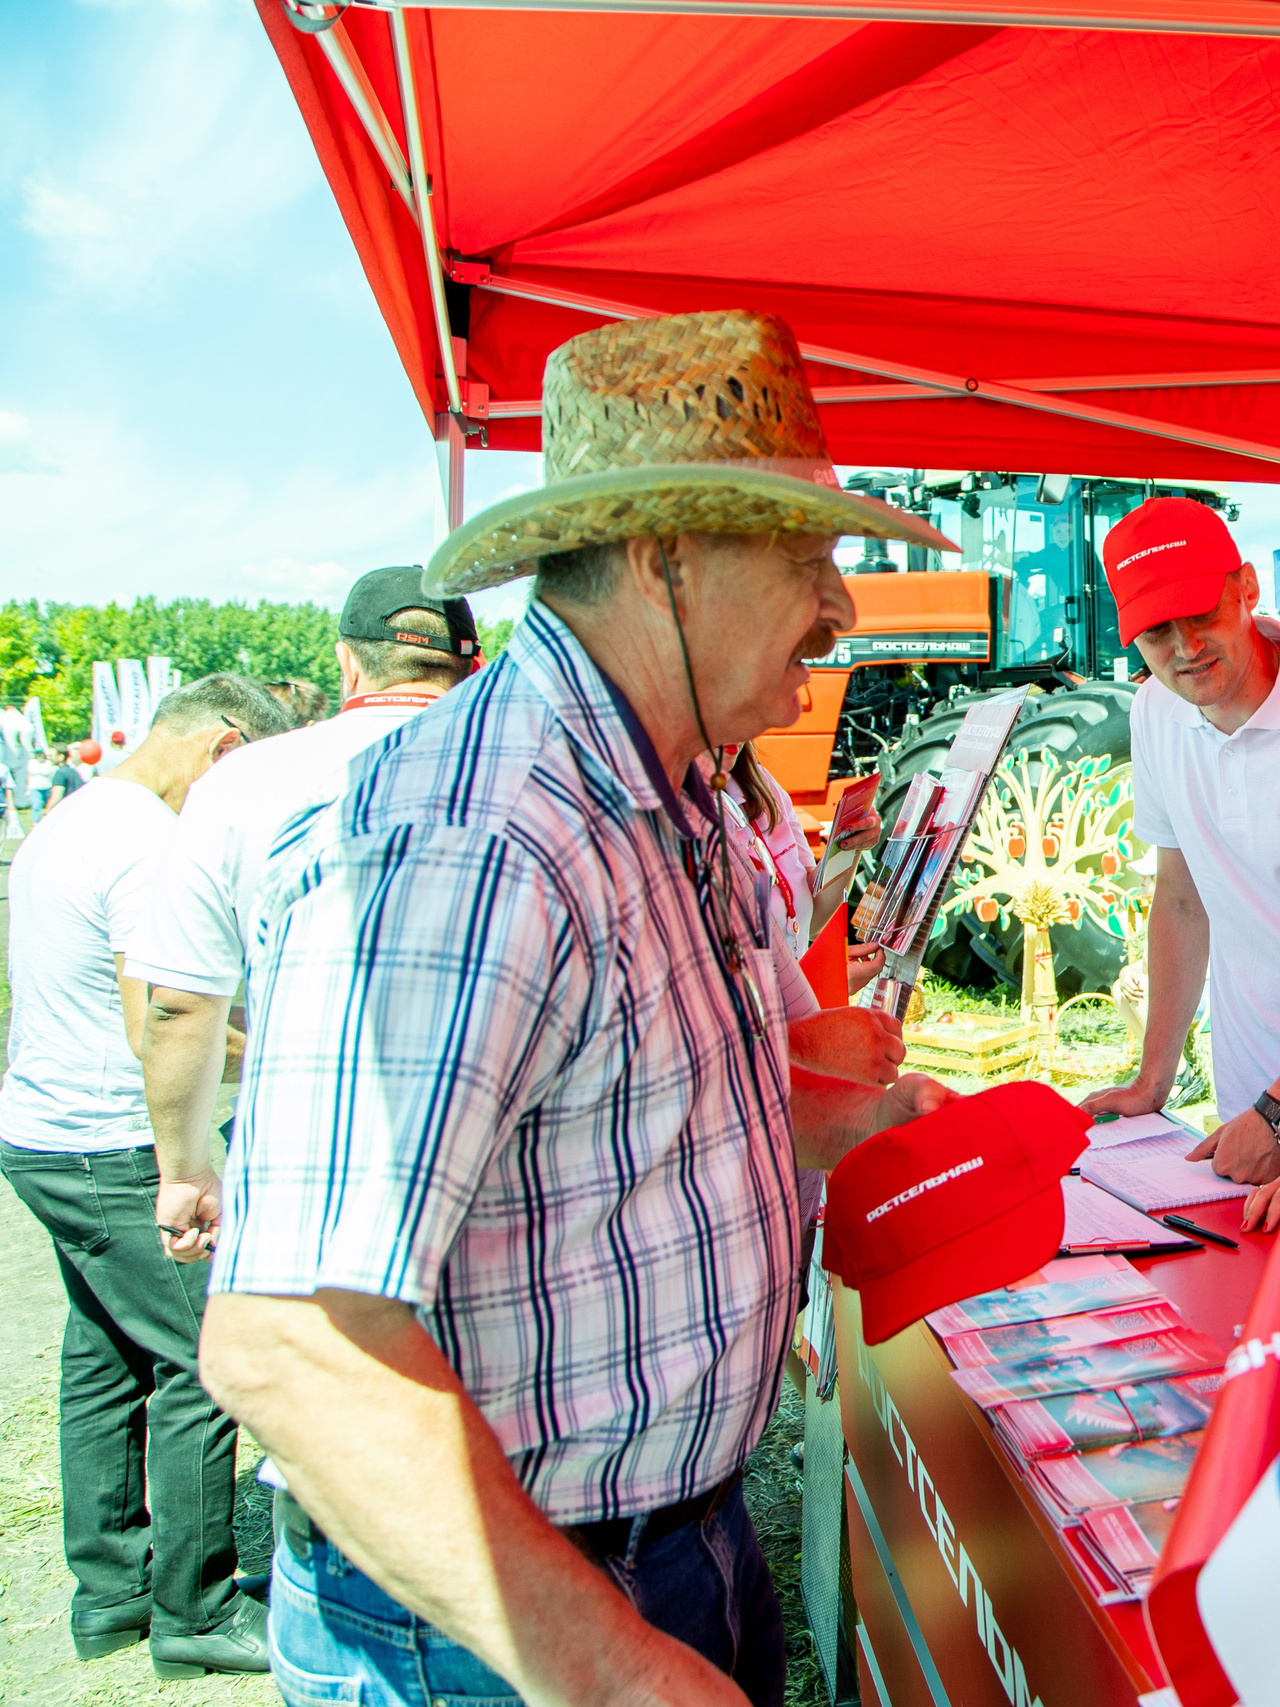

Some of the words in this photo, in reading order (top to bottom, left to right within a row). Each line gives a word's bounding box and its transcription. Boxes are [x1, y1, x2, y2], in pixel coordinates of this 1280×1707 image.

[1117, 540, 1186, 571] РОСТСЕЛЬМАШ
[396, 632, 430, 645] RSM
[872, 641, 970, 652] РОСТСЕЛЬМАШ
[866, 1156, 984, 1223] РОСТСЕЛЬМАШ
